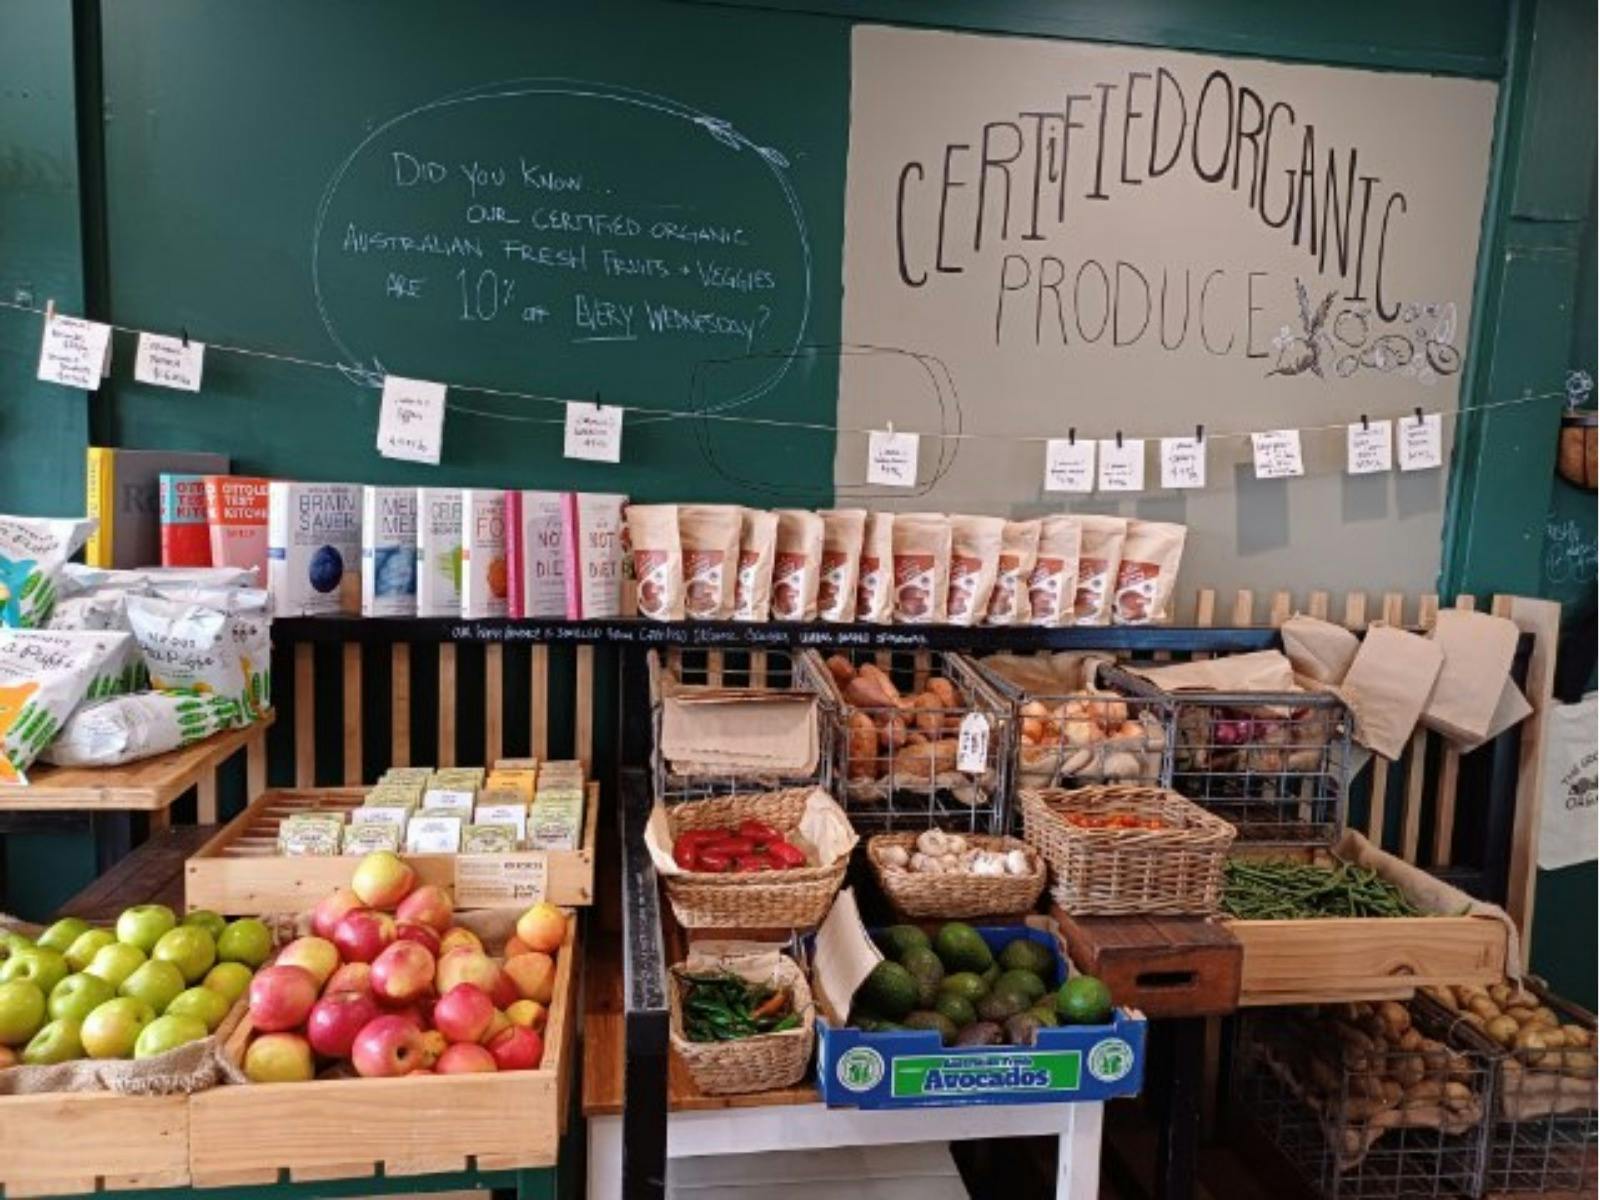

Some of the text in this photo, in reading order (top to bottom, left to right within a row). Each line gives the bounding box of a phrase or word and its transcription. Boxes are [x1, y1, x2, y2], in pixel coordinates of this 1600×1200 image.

[392, 151, 447, 187] DID
[1191, 69, 1408, 323] ORGANIC
[466, 204, 750, 246] OUR CERTIFIED ORGANIC
[343, 222, 484, 258] AUSTRALIAN
[500, 239, 587, 271] FRESH
[602, 250, 671, 279] FRUITS
[696, 259, 776, 293] VEGGIES
[386, 271, 427, 299] ARE
[573, 294, 635, 336] EVERY
[995, 254, 1270, 360] PRODUCE
[299, 494, 357, 512] BRAIN
[299, 512, 353, 531] SAVER
[588, 531, 616, 549] NOT
[588, 561, 617, 578] DIET
[924, 1068, 1049, 1091] Avocados
